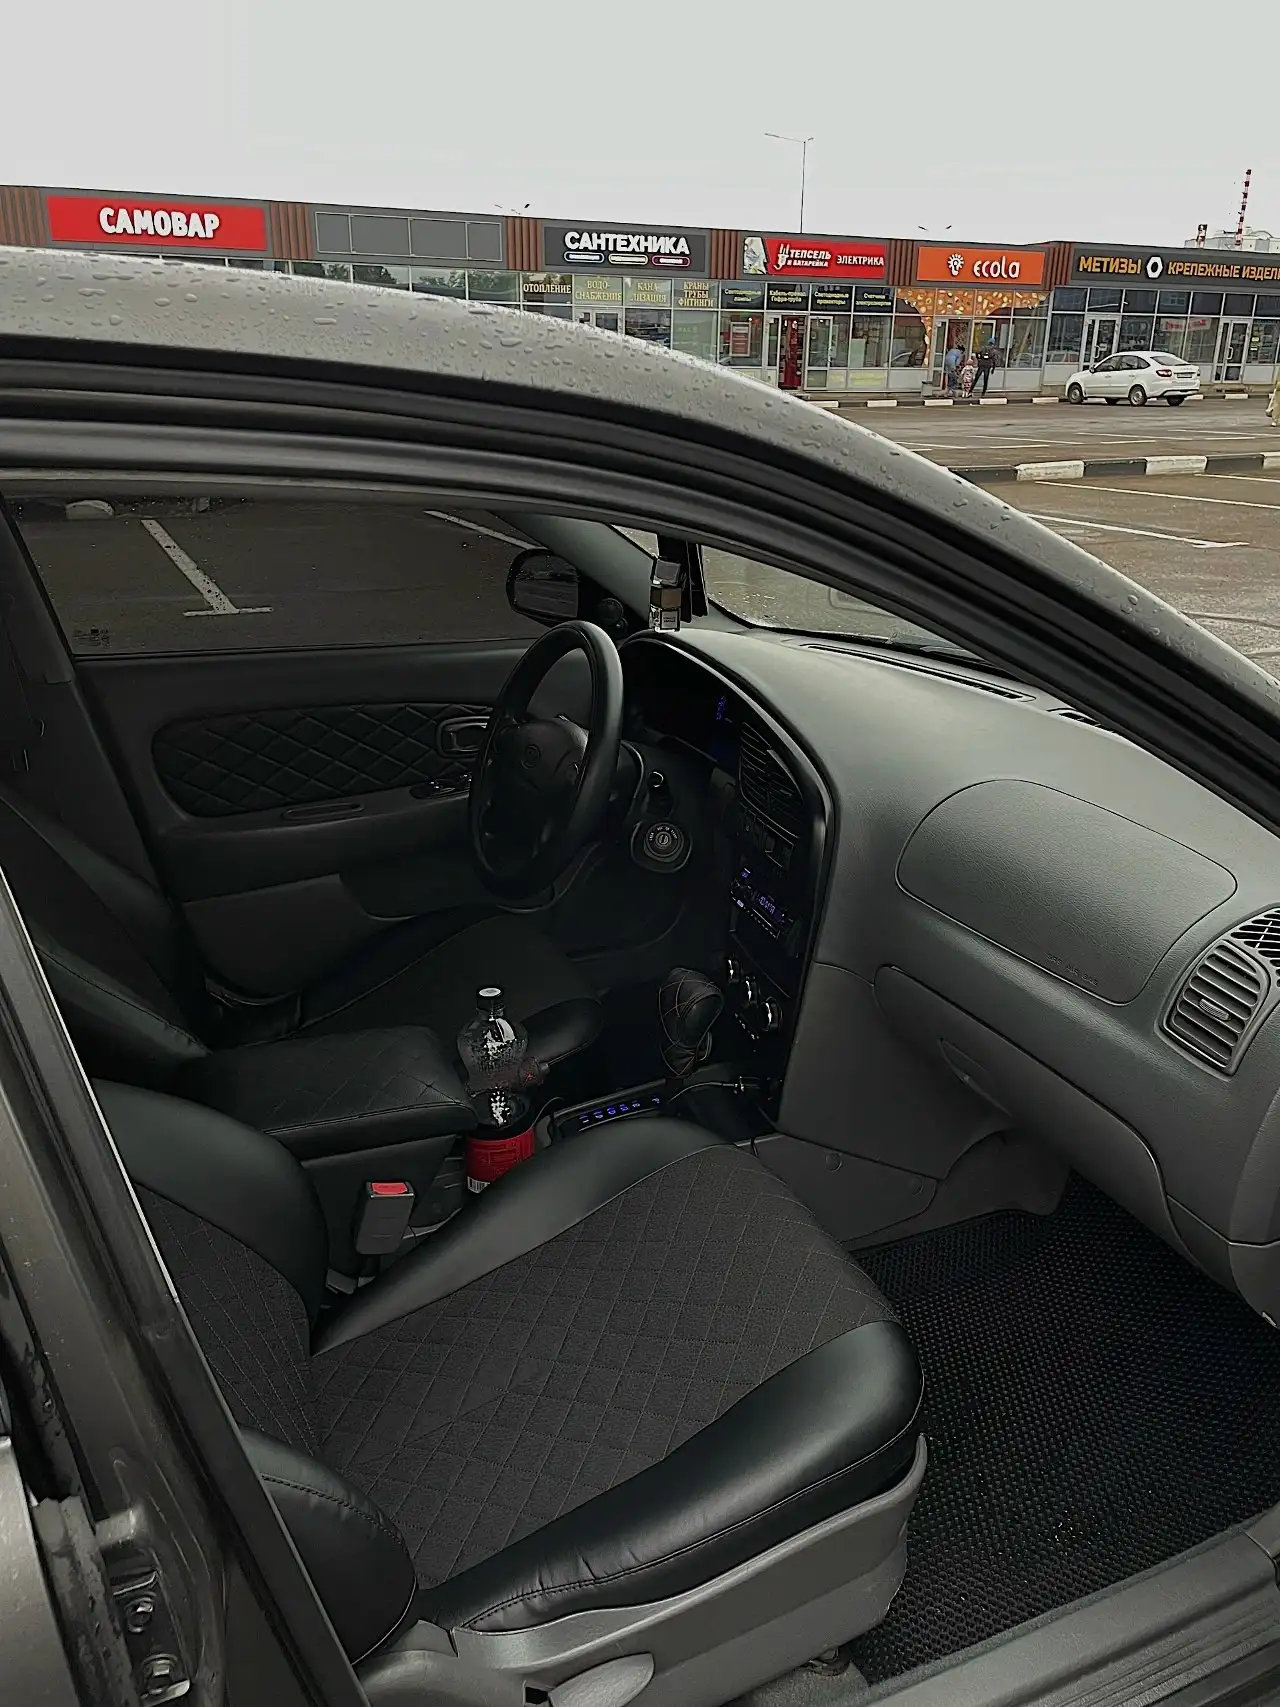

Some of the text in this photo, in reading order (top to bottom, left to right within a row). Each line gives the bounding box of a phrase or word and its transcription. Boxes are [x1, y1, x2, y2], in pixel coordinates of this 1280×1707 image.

[99, 207, 220, 239] САМОВАР
[564, 231, 690, 254] САНТЕХНИКА
[793, 260, 829, 268] БАТАРЕЙКА
[836, 255, 885, 266] ЭЛЕКТРИКА
[1079, 256, 1142, 274] МЕТИЗЫ
[973, 260, 1021, 279] ecola
[1167, 262, 1240, 278] КРЕПЕЖНЫЕ
[523, 283, 572, 294] ОТОПЛЕНИЕ
[683, 282, 709, 290] КРАНЫ
[575, 290, 622, 301] СНАБЖЕНИЕ
[684, 290, 709, 299] ТРУБЫ
[678, 298, 714, 307] ФИТИНГИ
